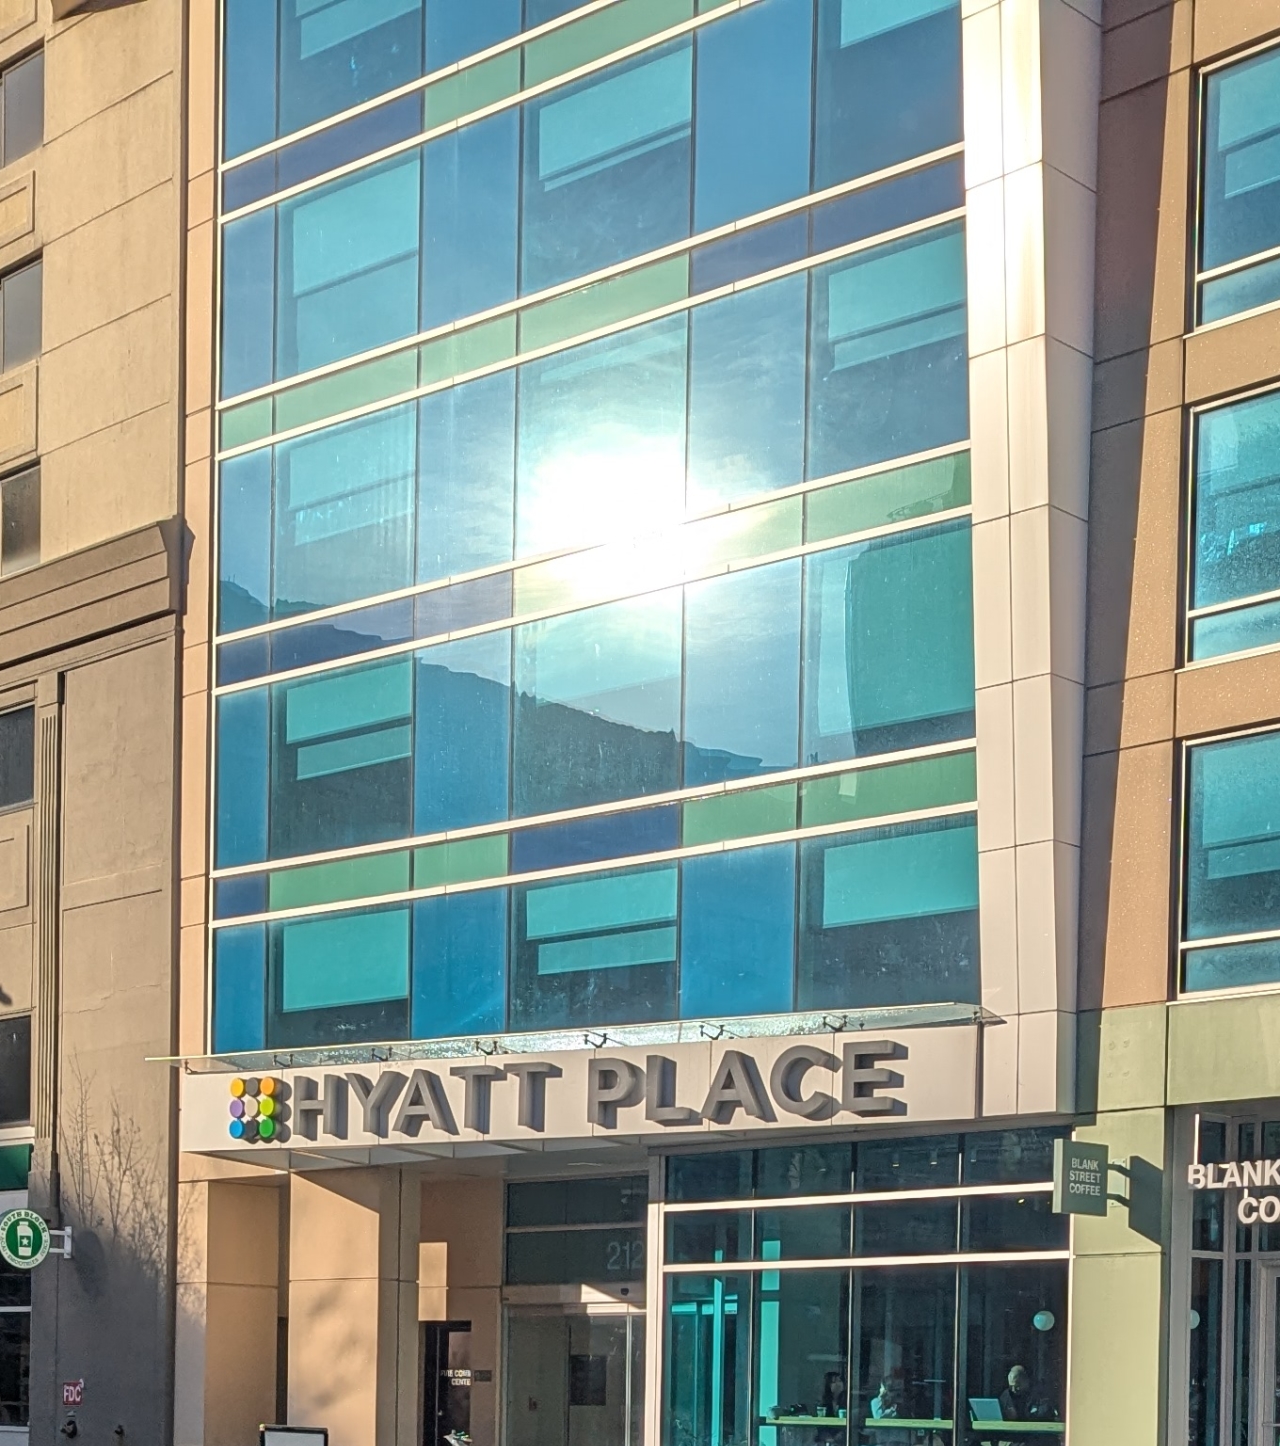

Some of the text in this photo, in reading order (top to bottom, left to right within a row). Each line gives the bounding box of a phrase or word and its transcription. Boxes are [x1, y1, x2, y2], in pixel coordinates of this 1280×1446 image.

[291, 1040, 908, 1141] HYATT PLACE
[1072, 1157, 1099, 1171] BLANK
[1069, 1171, 1101, 1183] STREET
[1069, 1183, 1100, 1196] COFFEE
[0, 1211, 48, 1234] SOUTH BLOCK
[64, 1385, 81, 1401] FDC
